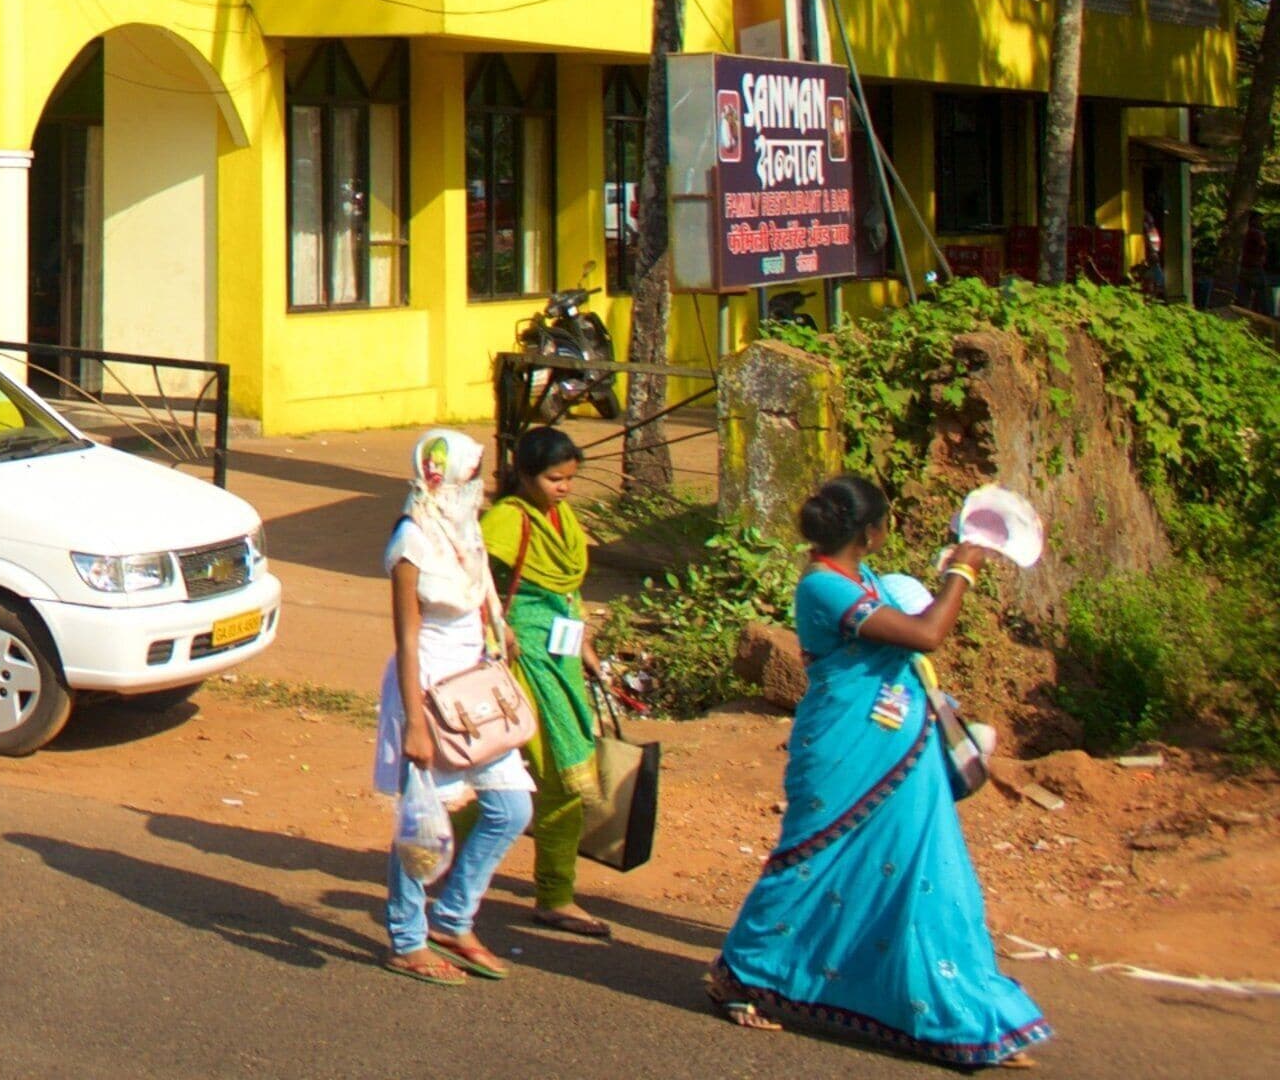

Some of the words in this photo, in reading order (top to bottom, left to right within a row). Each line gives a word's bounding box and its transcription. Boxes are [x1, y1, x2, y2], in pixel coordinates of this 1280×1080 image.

[741, 73, 827, 135] SANMAN
[755, 134, 825, 189] सन्मान
[724, 192, 761, 218] FAMILY
[761, 189, 822, 217] RESTAURANT
[831, 188, 850, 212] BAR
